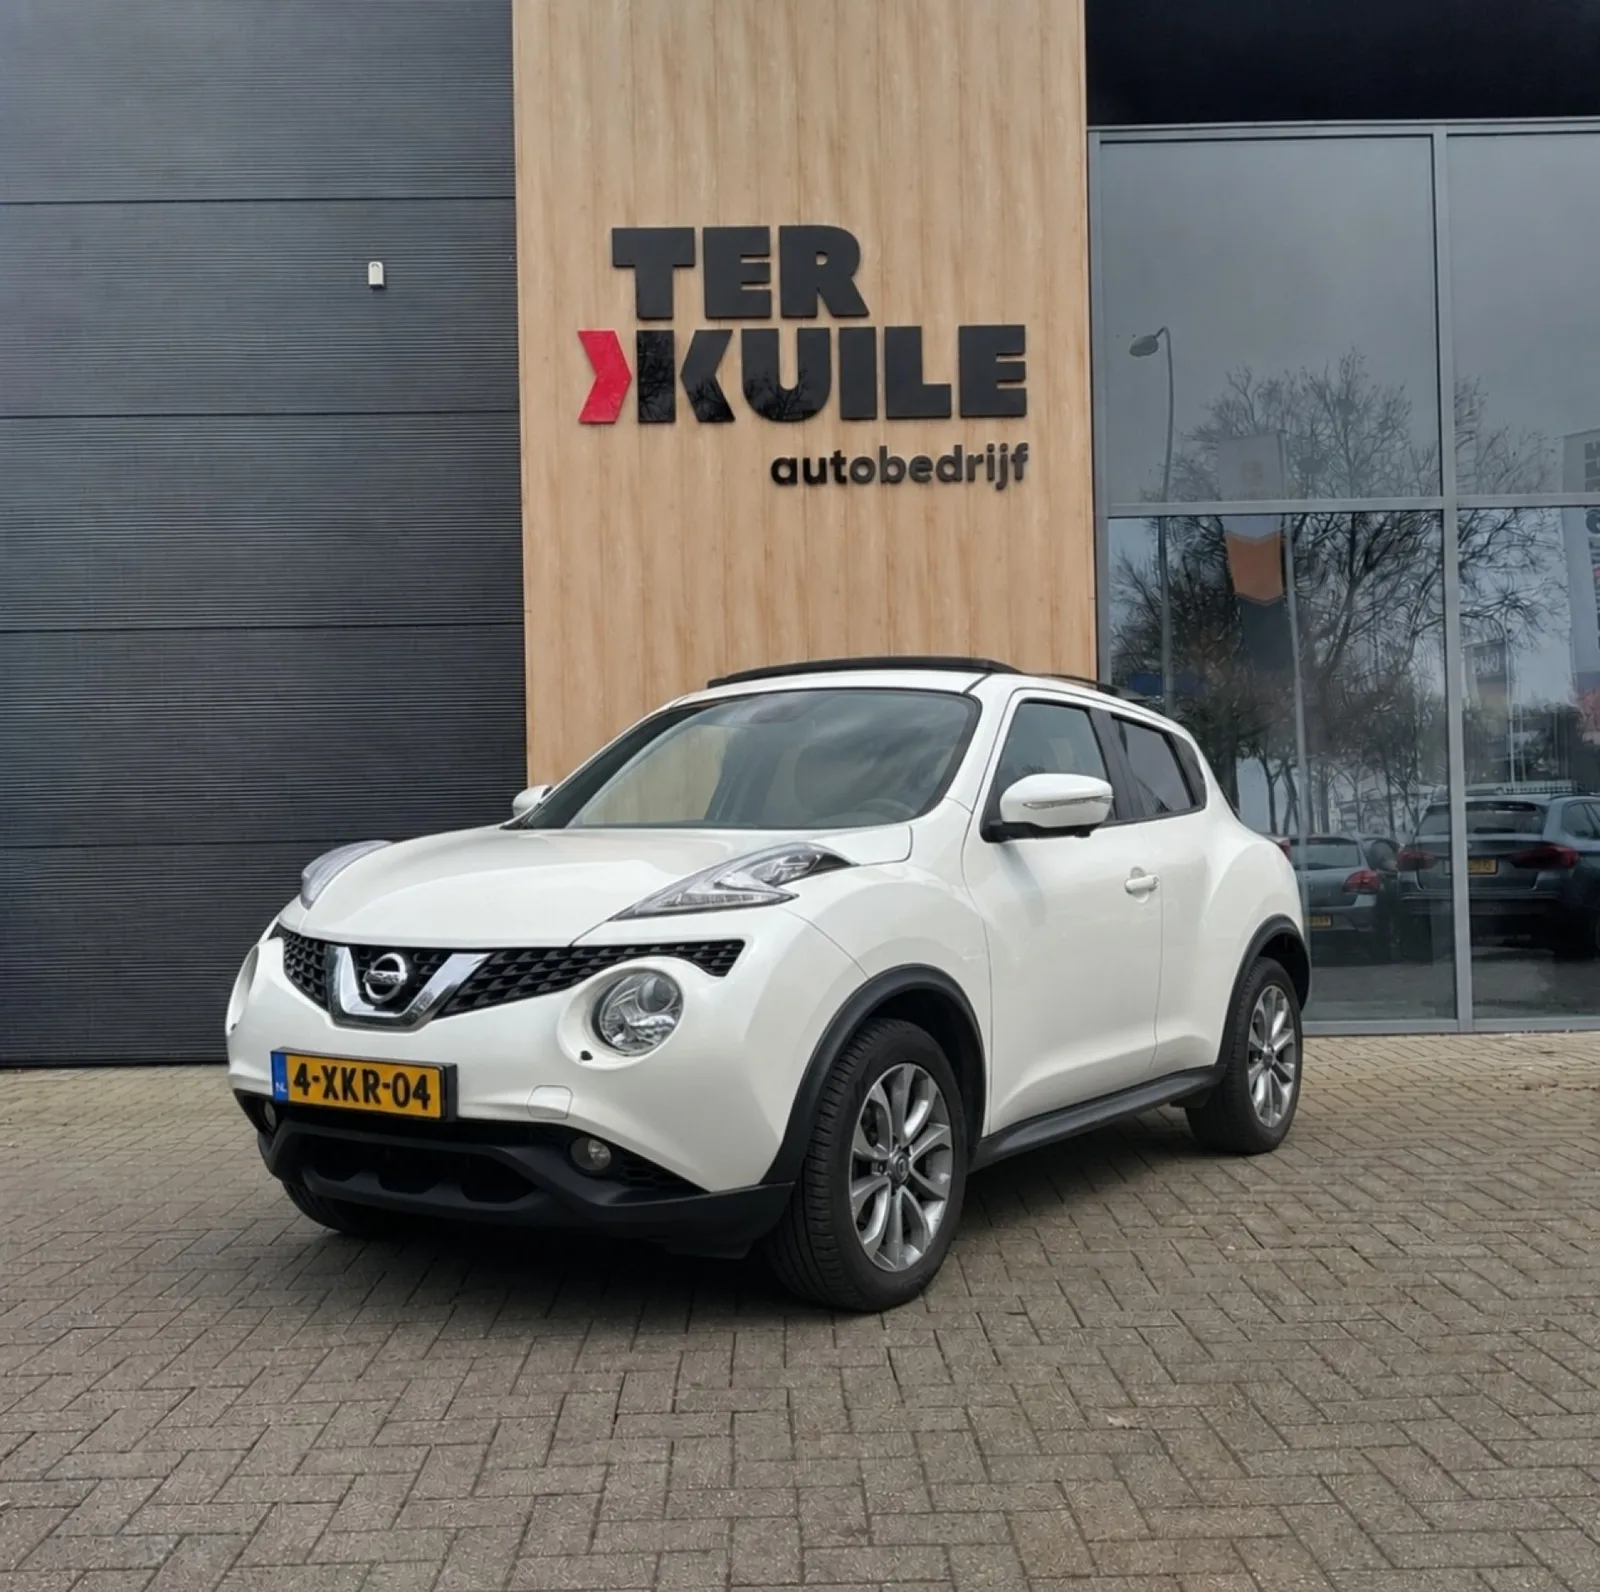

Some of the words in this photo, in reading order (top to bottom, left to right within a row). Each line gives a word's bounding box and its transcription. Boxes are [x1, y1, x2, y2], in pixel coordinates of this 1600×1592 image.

[612, 225, 869, 320] TER
[636, 325, 1027, 424] KUILE
[770, 442, 1029, 490] autobedrijf
[293, 1062, 431, 1111] 4-XKR-04
